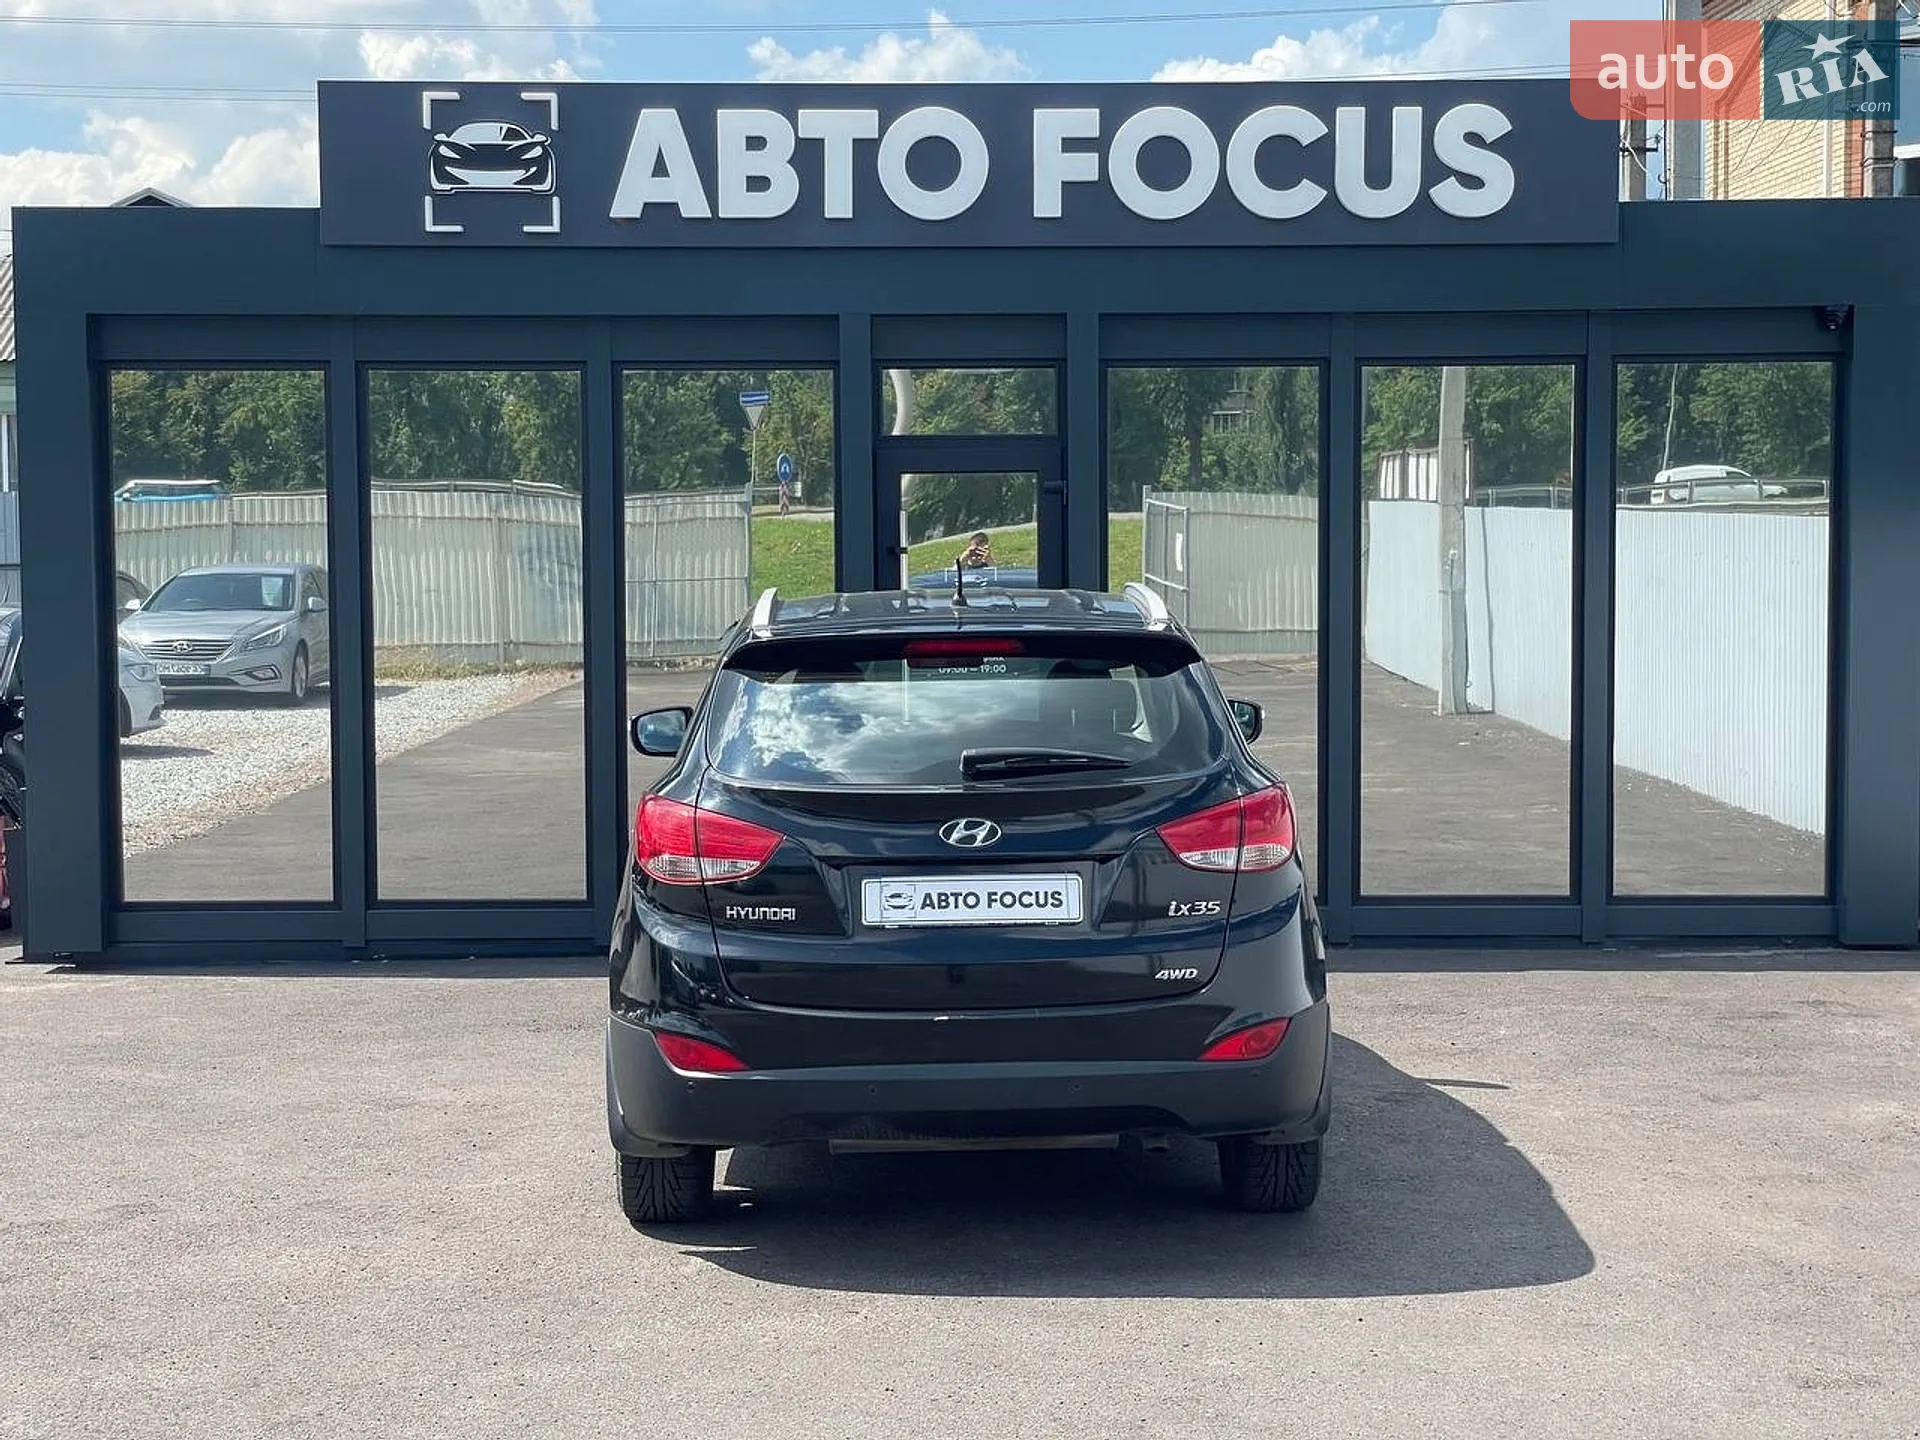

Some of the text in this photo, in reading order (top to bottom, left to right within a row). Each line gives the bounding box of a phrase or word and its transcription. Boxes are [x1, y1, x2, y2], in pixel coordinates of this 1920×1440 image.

[608, 103, 1515, 221] АВТО FOCUS
[980, 664, 1007, 673] 19:00
[986, 890, 1064, 909] FOCUS
[725, 905, 796, 921] HYUNDAI
[1168, 900, 1221, 917] ix35
[1154, 968, 1199, 980] 4WD
